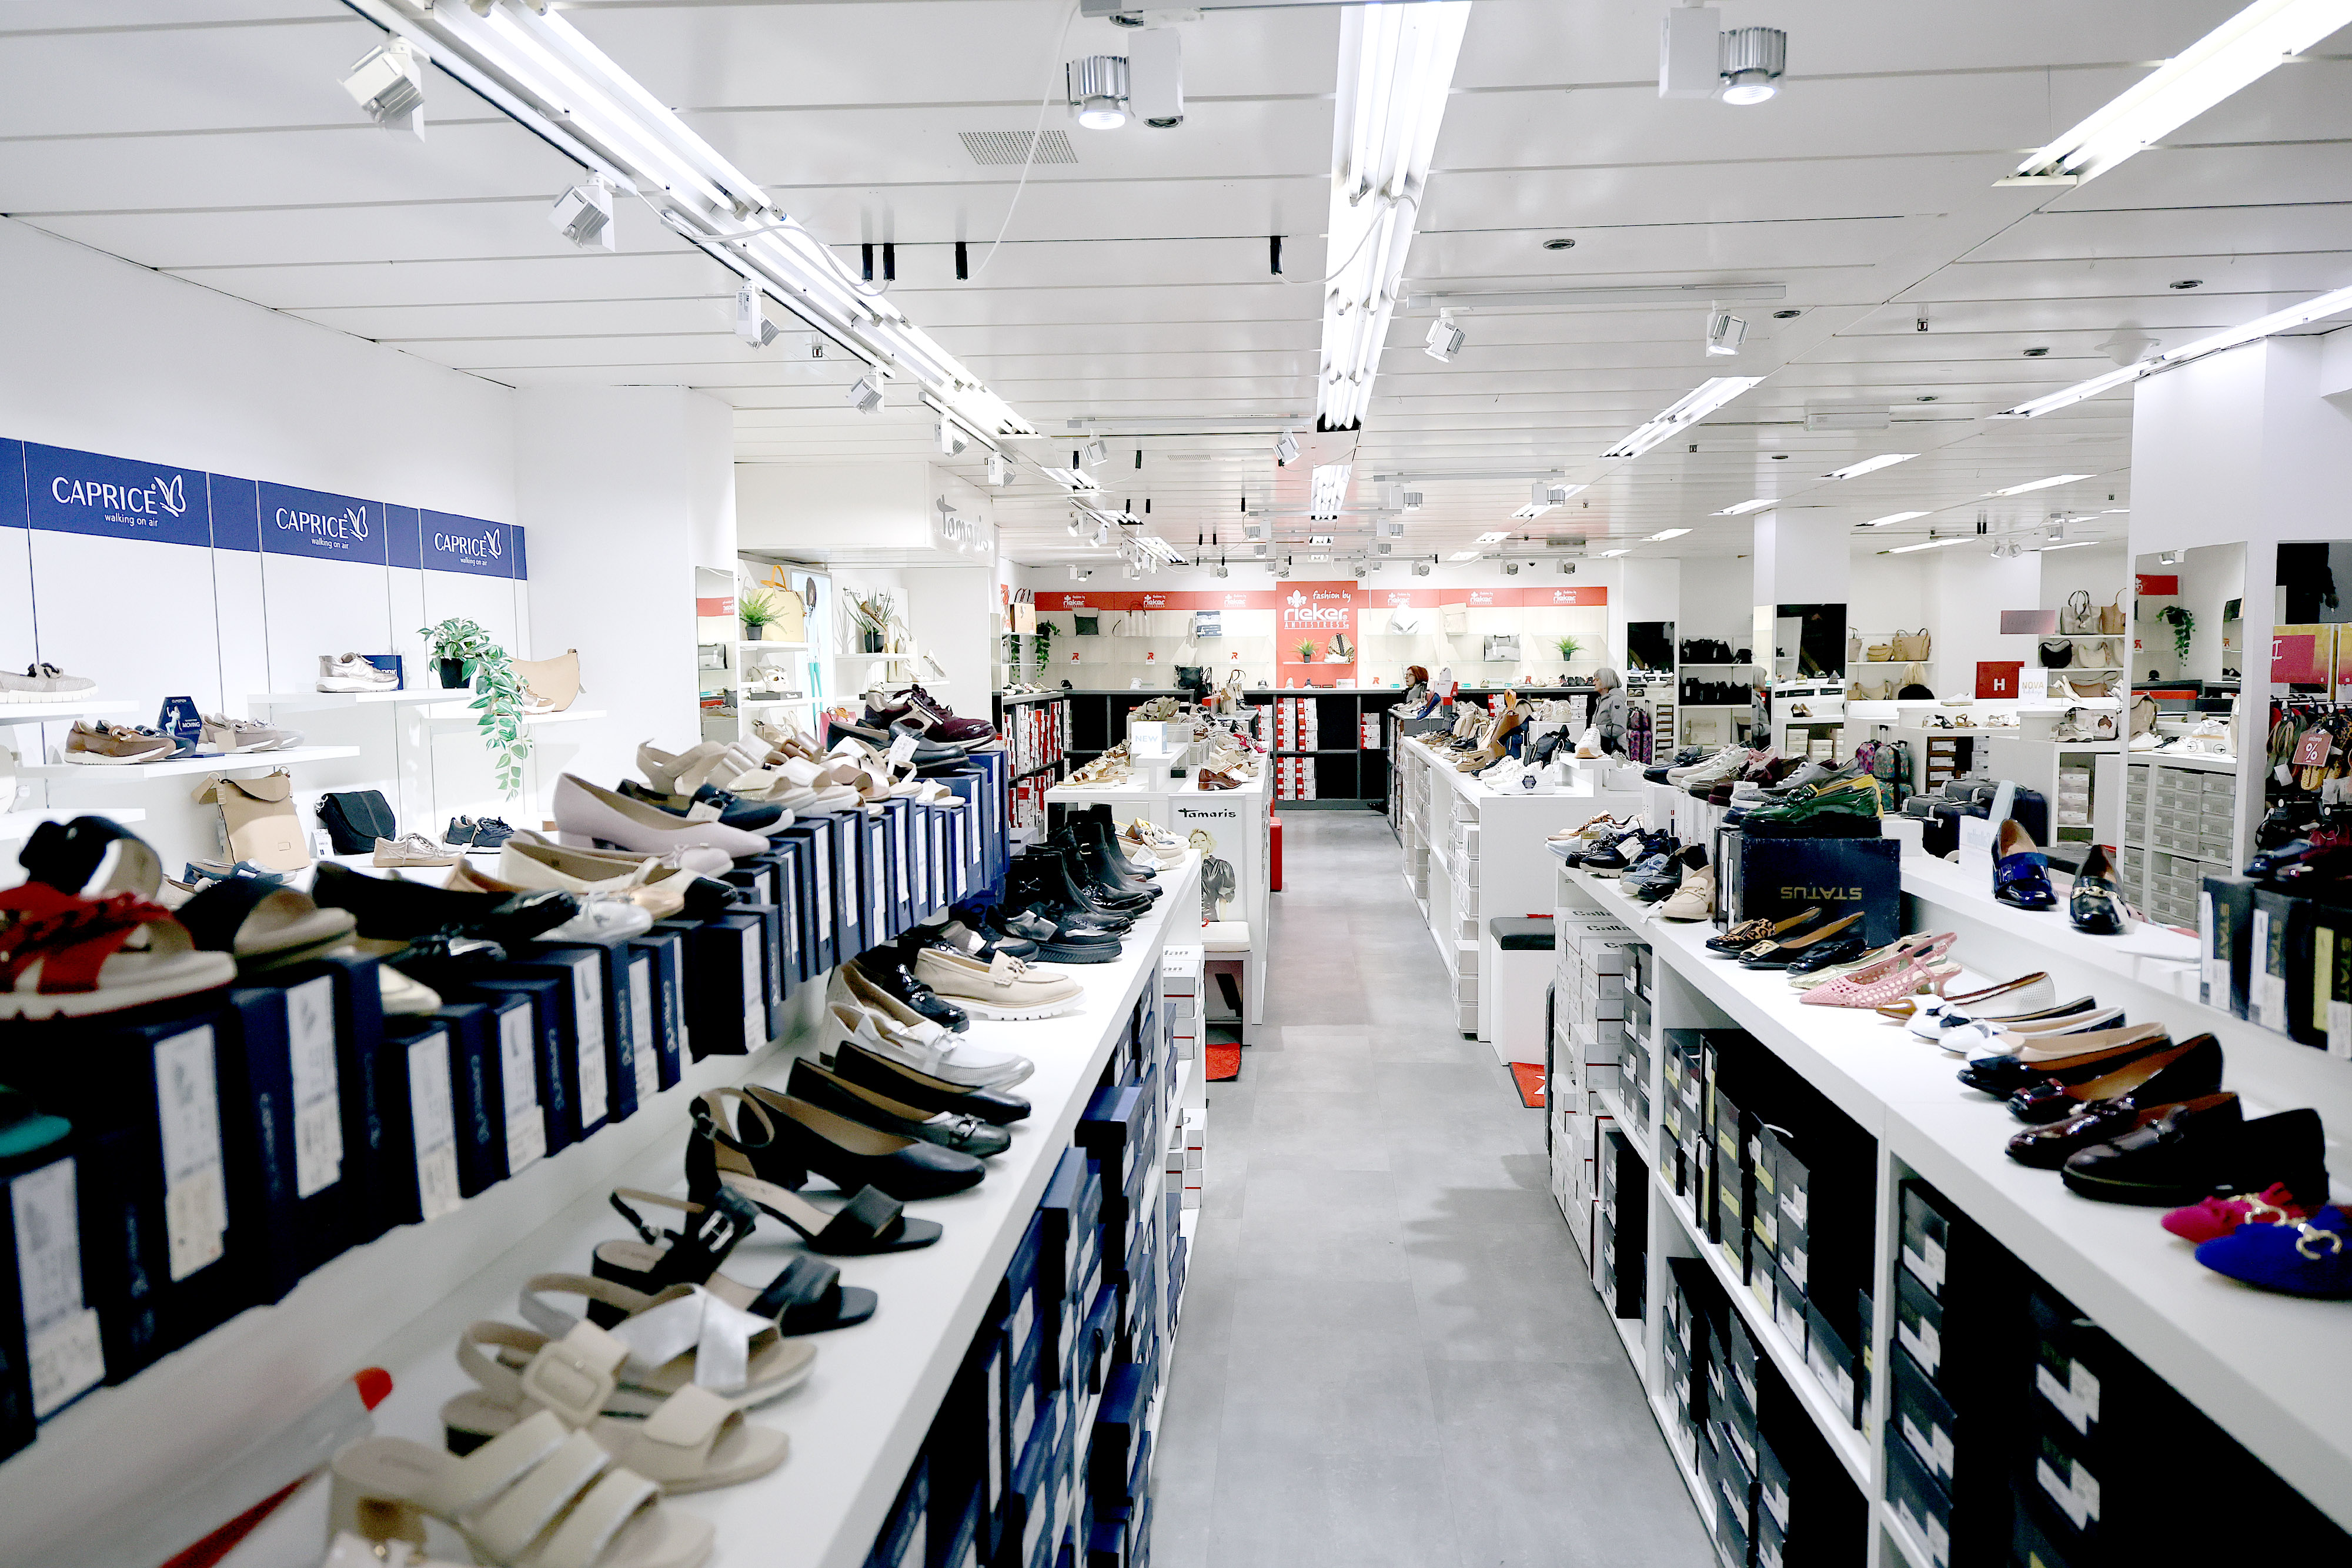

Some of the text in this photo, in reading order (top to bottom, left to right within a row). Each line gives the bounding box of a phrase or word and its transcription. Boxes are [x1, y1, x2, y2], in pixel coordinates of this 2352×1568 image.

[52, 476, 158, 514] CAPRICE
[105, 513, 158, 527] walking on air
[276, 507, 349, 539] CAPRICE
[936, 494, 989, 551] Tamaris
[311, 537, 332, 549] walking
[434, 532, 487, 557] CAPRICE
[460, 557, 475, 566] walking
[1312, 590, 1351, 603] fashion by
[1284, 603, 1349, 621] rieker
[1993, 678, 2006, 691] H
[1178, 808, 1237, 818] Tamaris
[1780, 887, 1863, 901] STATUS
